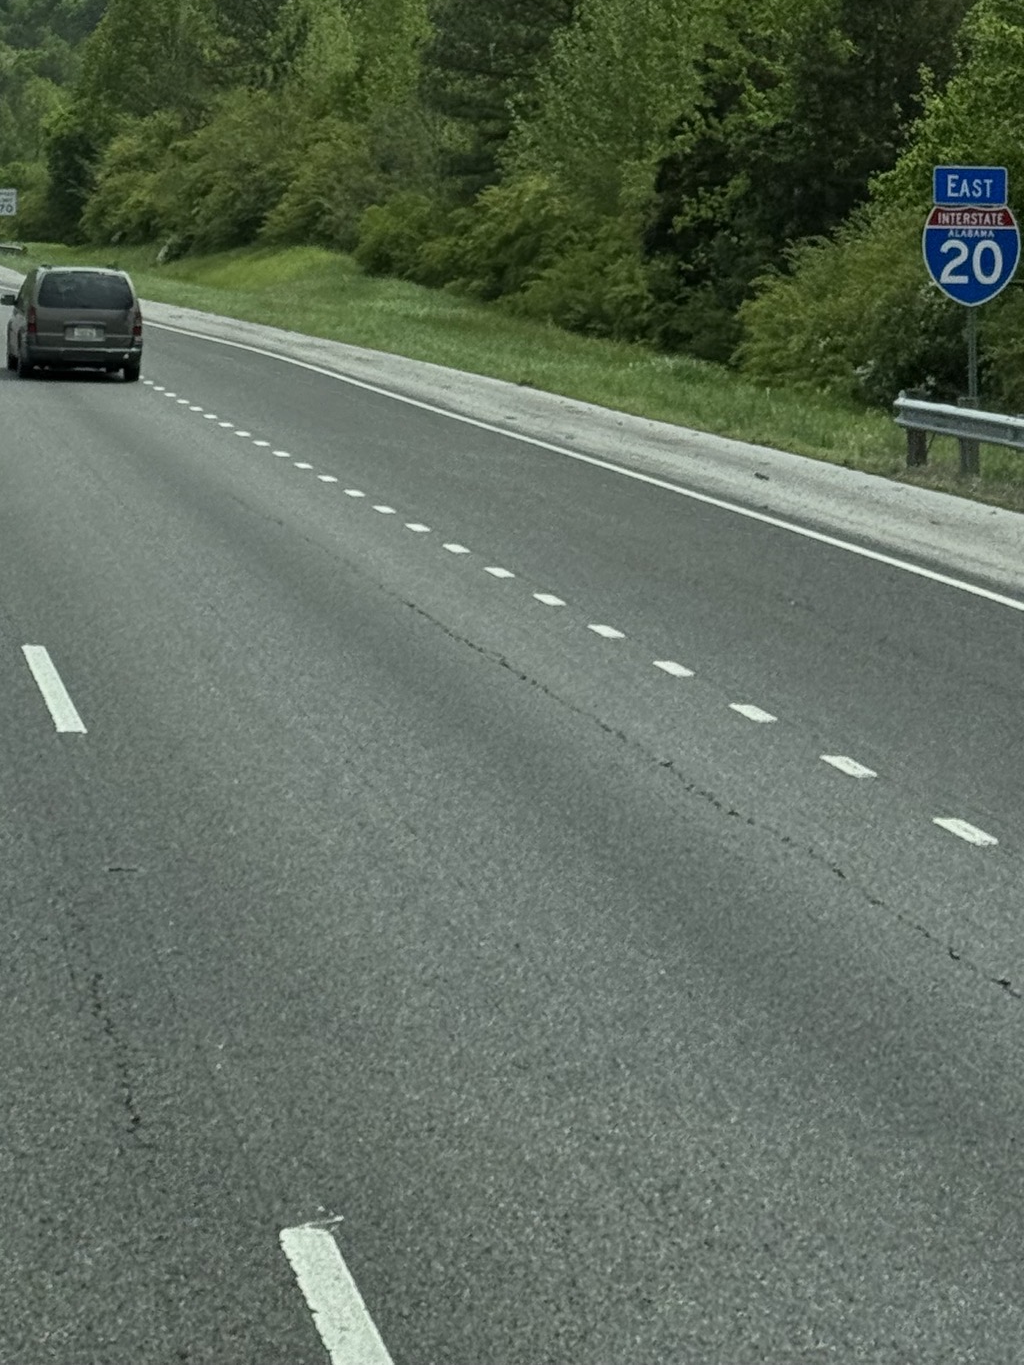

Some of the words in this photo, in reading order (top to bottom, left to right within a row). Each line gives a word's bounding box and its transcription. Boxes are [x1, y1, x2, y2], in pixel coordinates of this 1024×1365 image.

[946, 174, 994, 199] EAST
[937, 212, 1005, 226] INTERSTATE
[947, 229, 995, 238] ALABAMA
[939, 239, 1004, 285] 20
